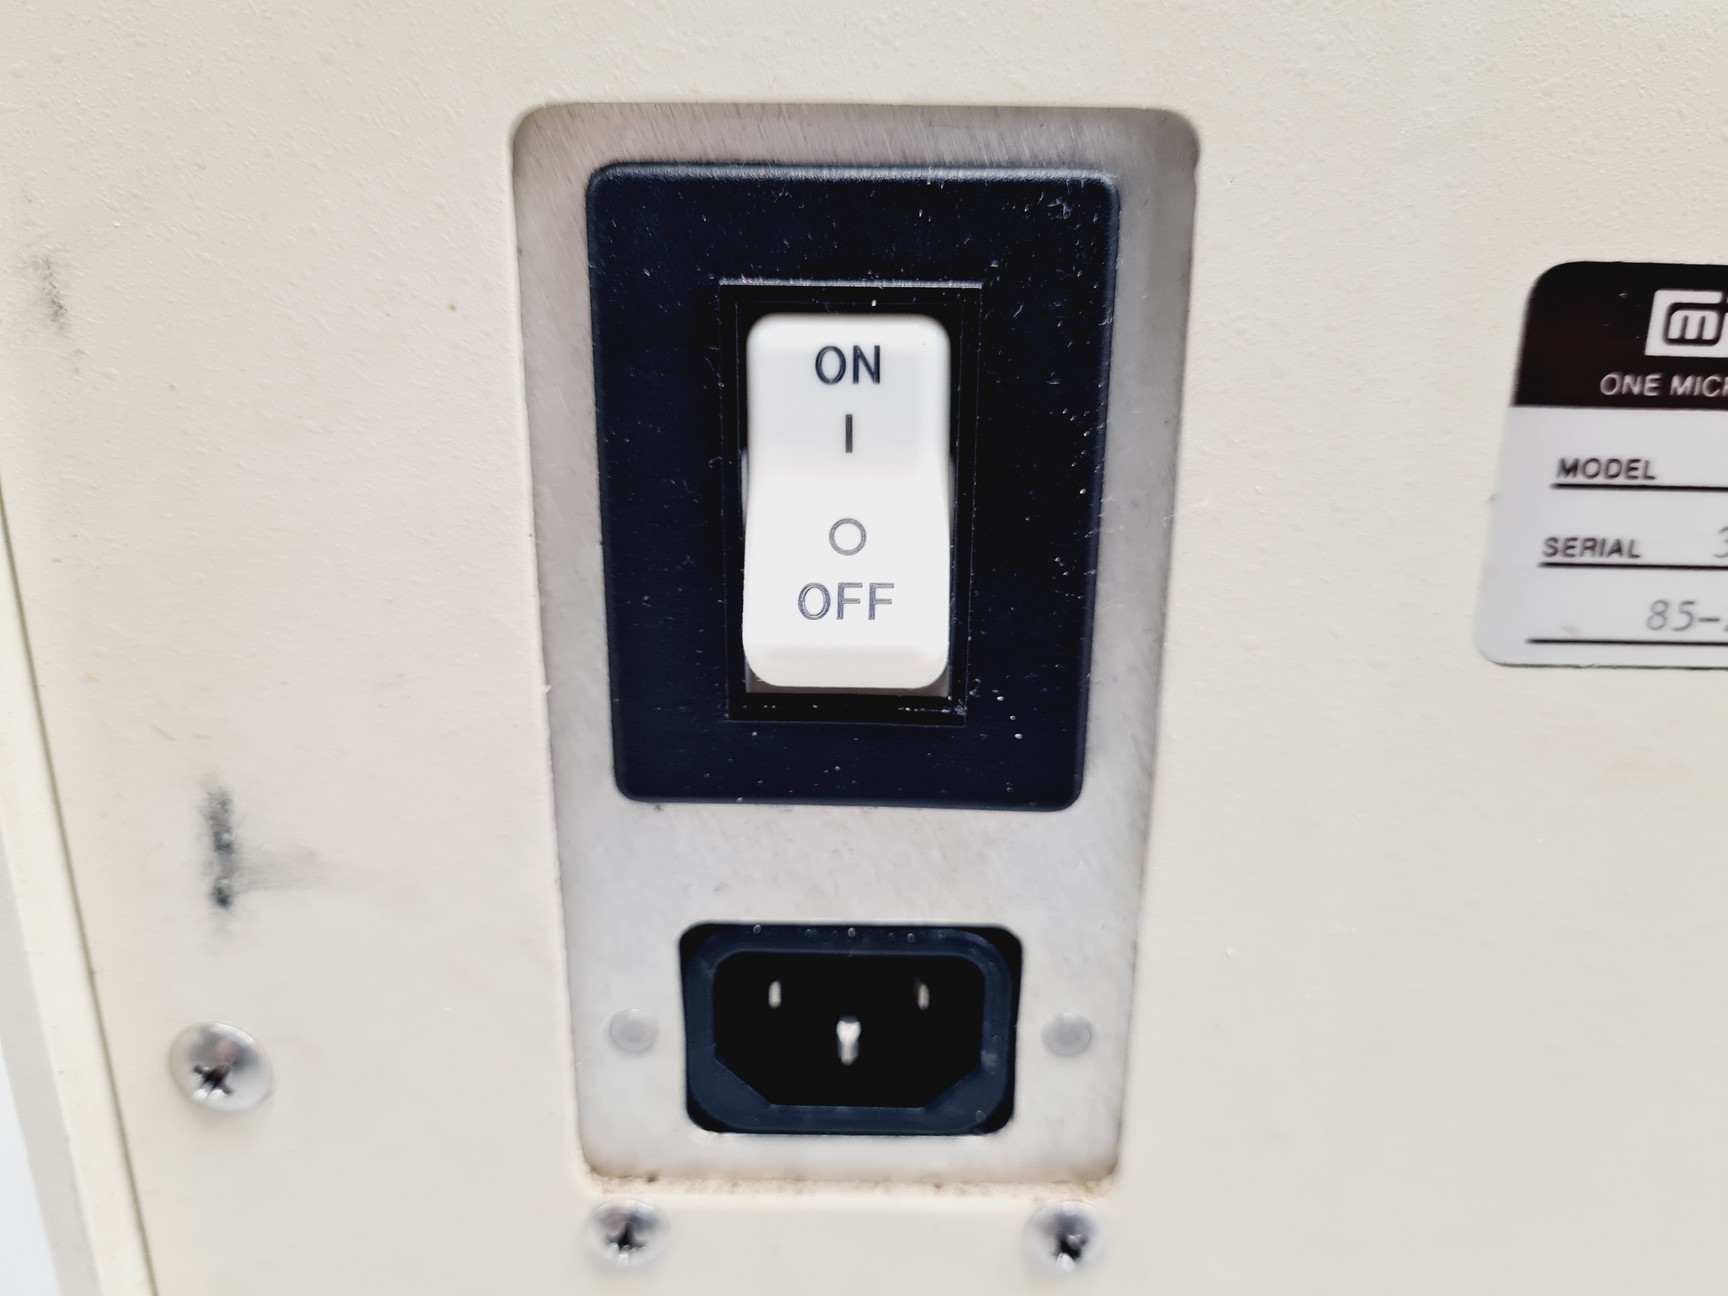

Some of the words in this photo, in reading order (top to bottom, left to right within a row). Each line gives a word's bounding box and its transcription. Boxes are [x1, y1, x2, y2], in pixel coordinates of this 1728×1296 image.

[815, 344, 881, 385] ON
[1600, 373, 1661, 396] ONE
[1556, 456, 1656, 481] MODEL
[1542, 536, 1641, 559] SERIAL
[797, 582, 895, 620] OFF
